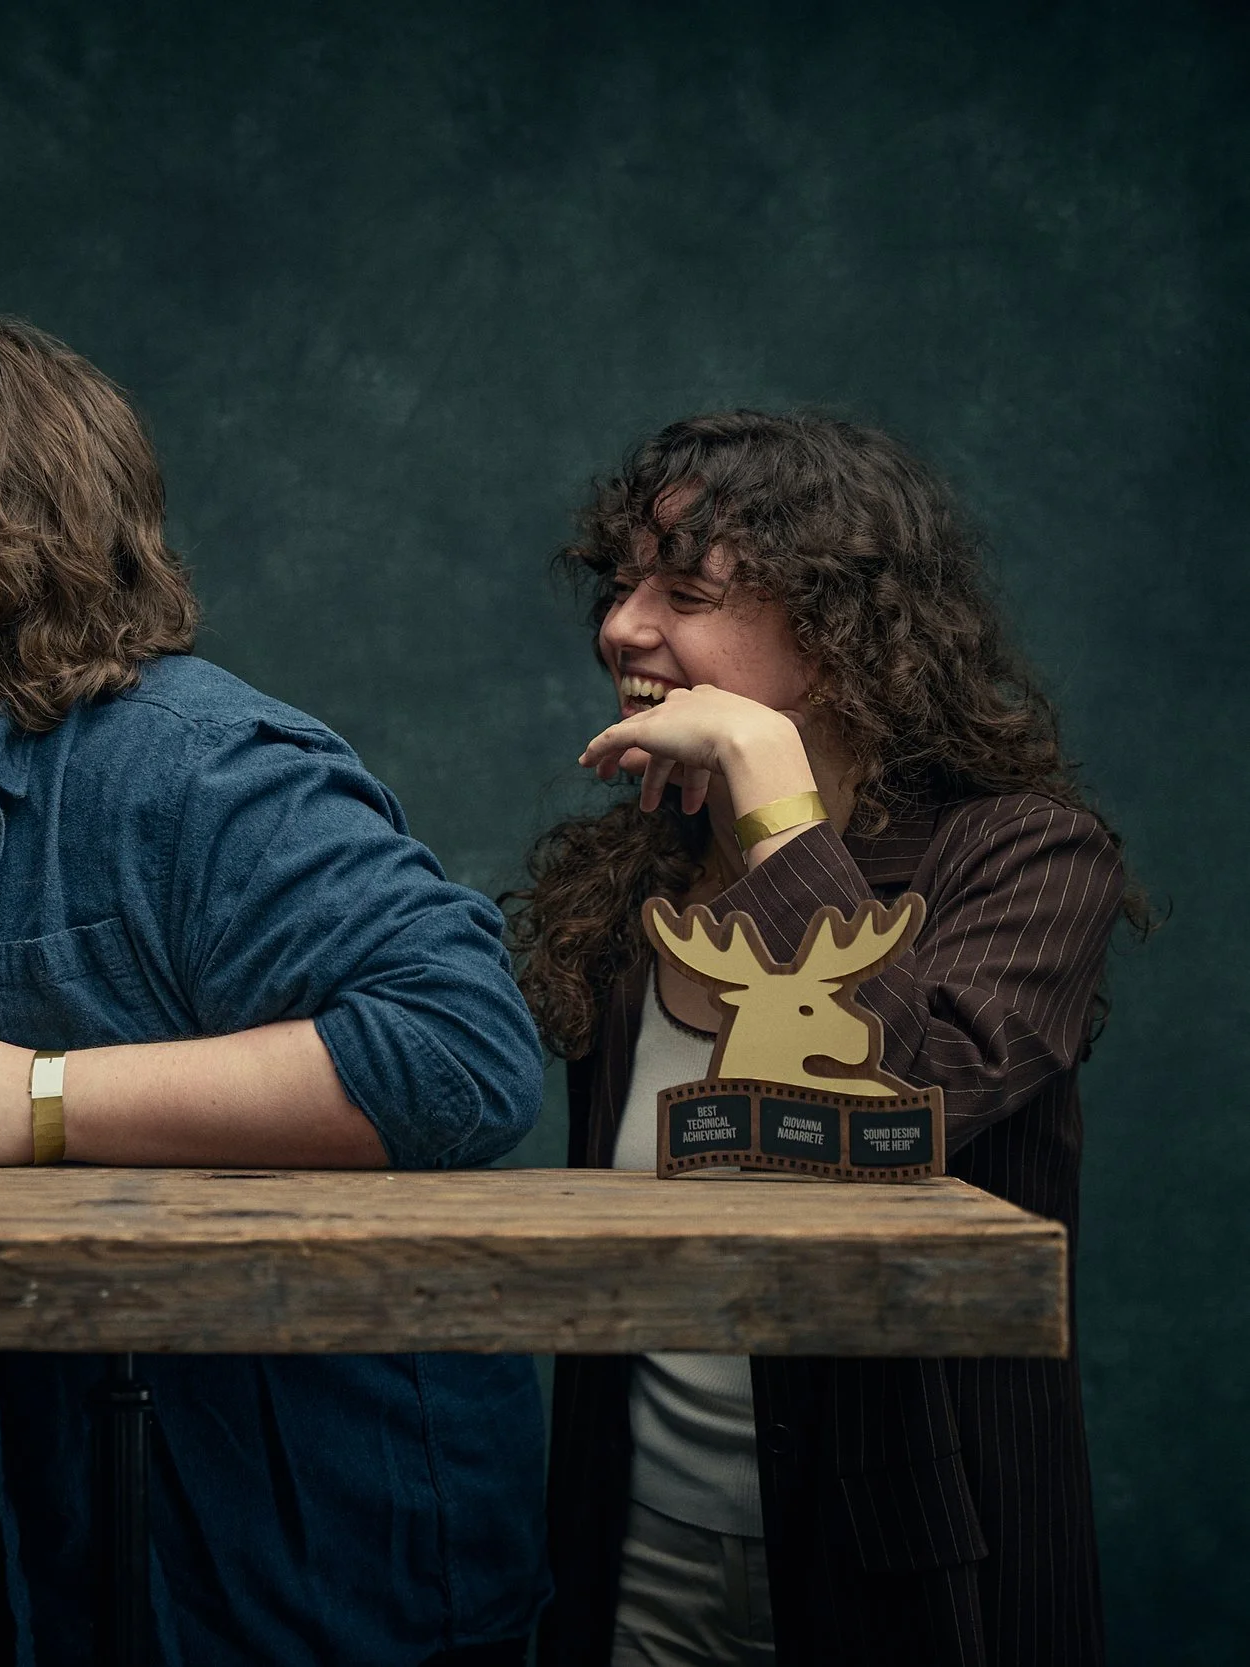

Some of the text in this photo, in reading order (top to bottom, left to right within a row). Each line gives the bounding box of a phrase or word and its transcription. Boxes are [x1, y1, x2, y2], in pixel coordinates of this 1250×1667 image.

[697, 1106, 717, 1117] BEST
[687, 1117, 730, 1129] TECHNICAL
[783, 1116, 822, 1133] GIOVANNA
[682, 1127, 737, 1143] ACHIEVEMENT
[777, 1127, 824, 1144] NABARRETE
[863, 1127, 920, 1140] SOUND DESIGN
[870, 1140, 914, 1152] "THE HEIR"
